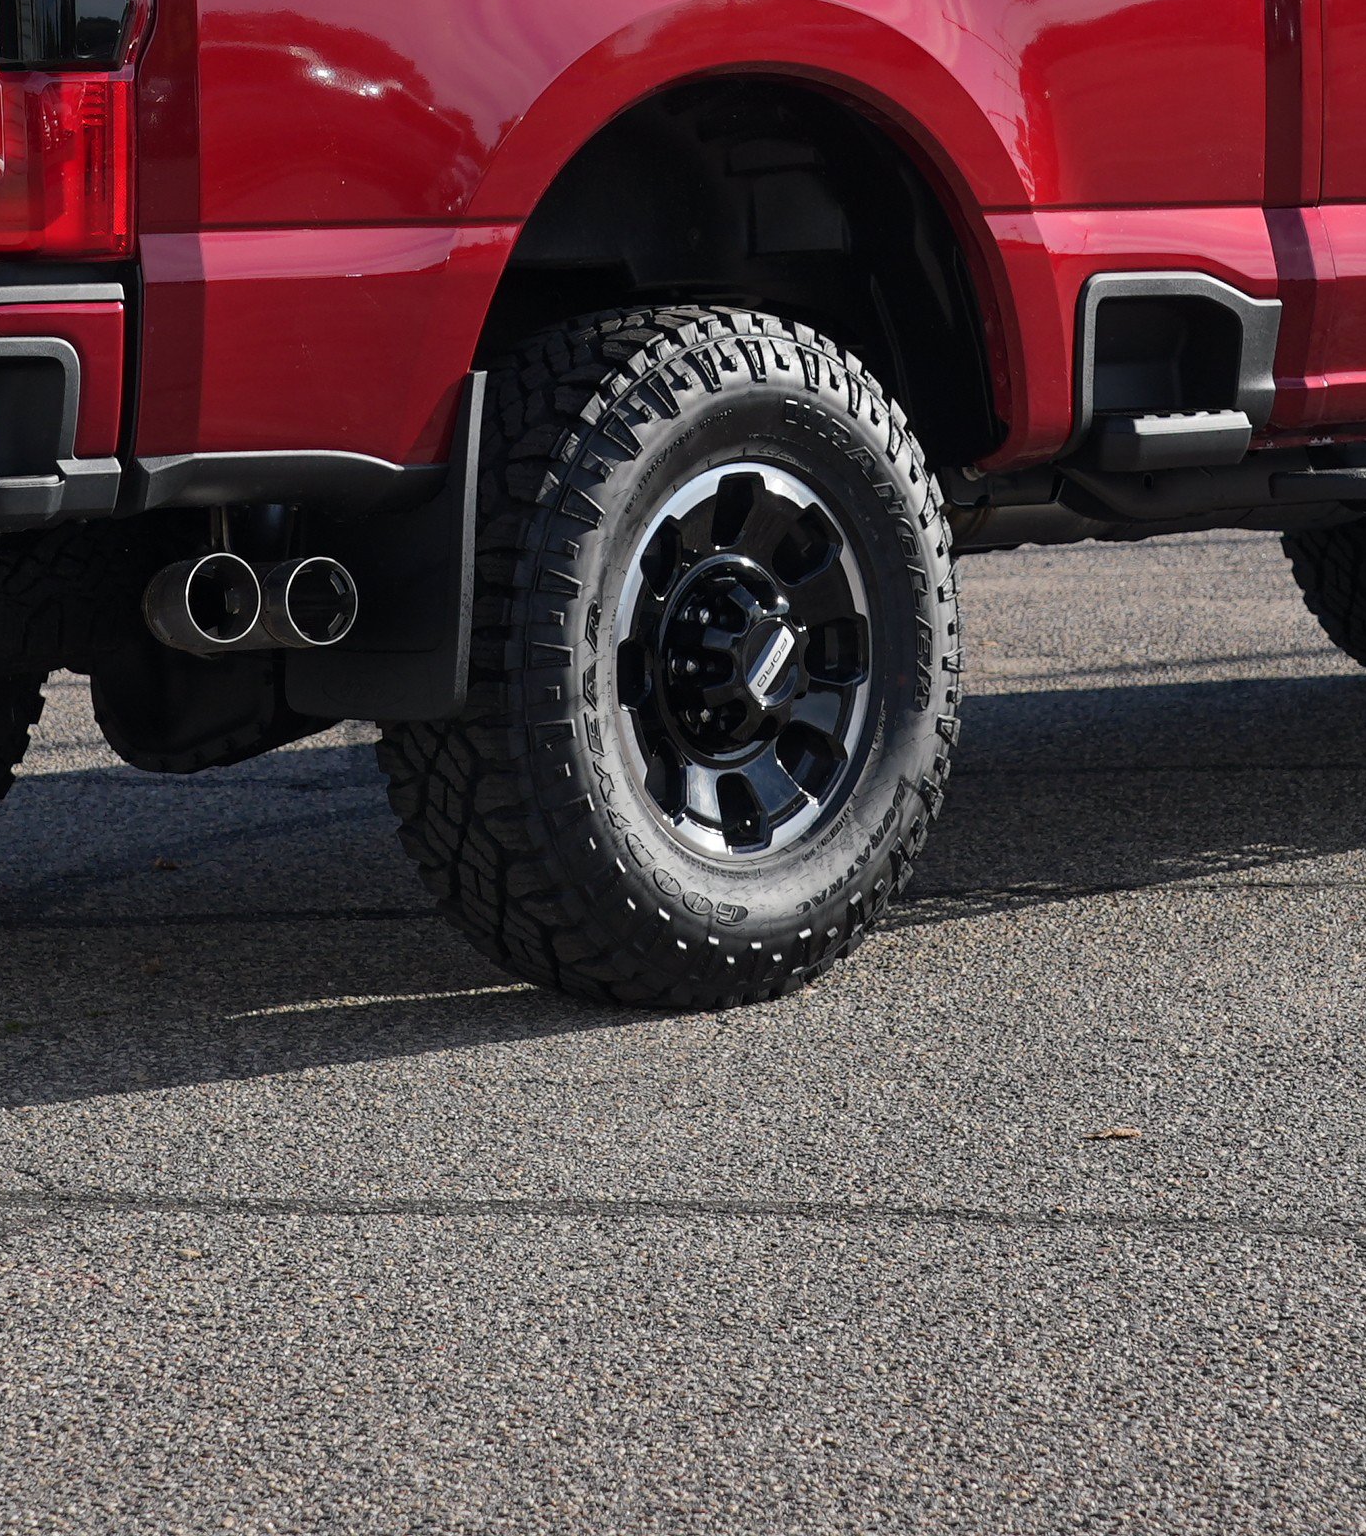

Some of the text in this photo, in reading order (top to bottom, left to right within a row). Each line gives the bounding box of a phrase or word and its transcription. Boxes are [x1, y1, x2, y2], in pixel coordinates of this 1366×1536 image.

[757, 638, 788, 688] FORD
[784, 398, 934, 712] WRANGLER
[583, 600, 749, 927] GOODYEAR
[795, 780, 906, 916] DURATRAC
